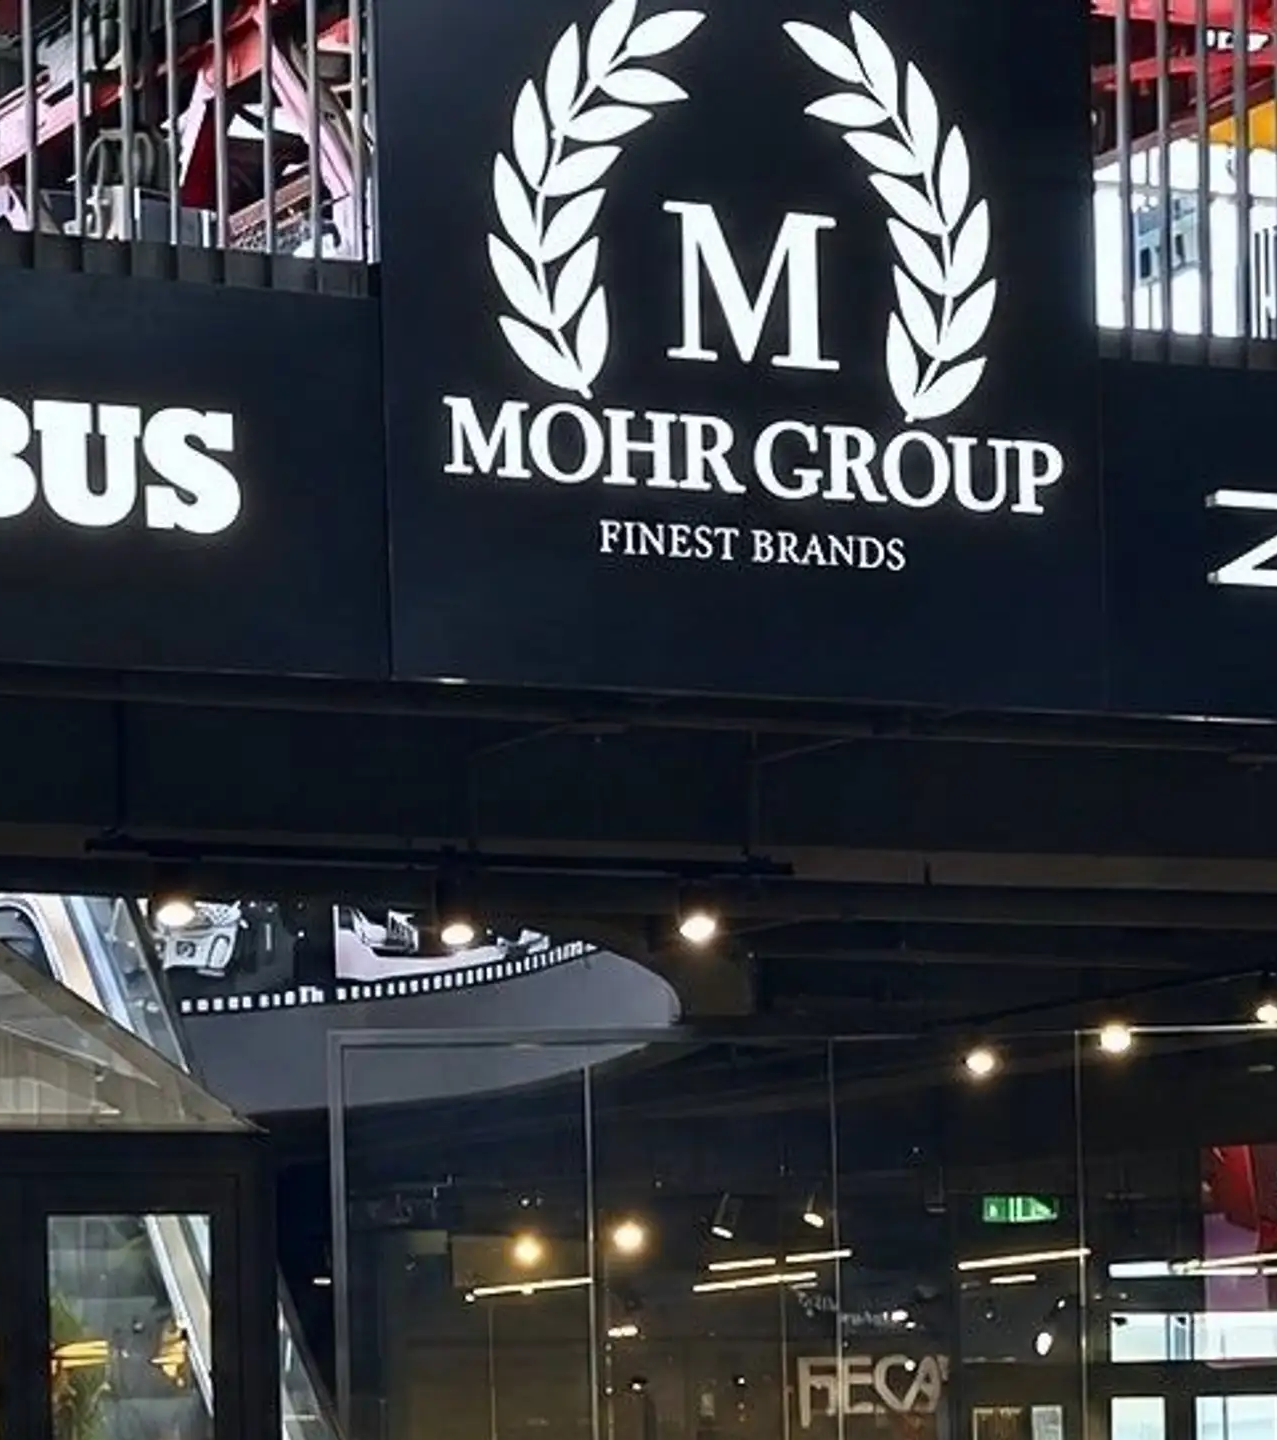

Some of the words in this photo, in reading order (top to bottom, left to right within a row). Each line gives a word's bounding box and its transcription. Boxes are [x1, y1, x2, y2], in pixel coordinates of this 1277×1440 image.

[662, 200, 841, 371] M
[441, 394, 747, 495] MOHR
[752, 420, 1065, 516] GROUP
[599, 518, 740, 562] FINEST
[751, 528, 907, 572] BRANDS
